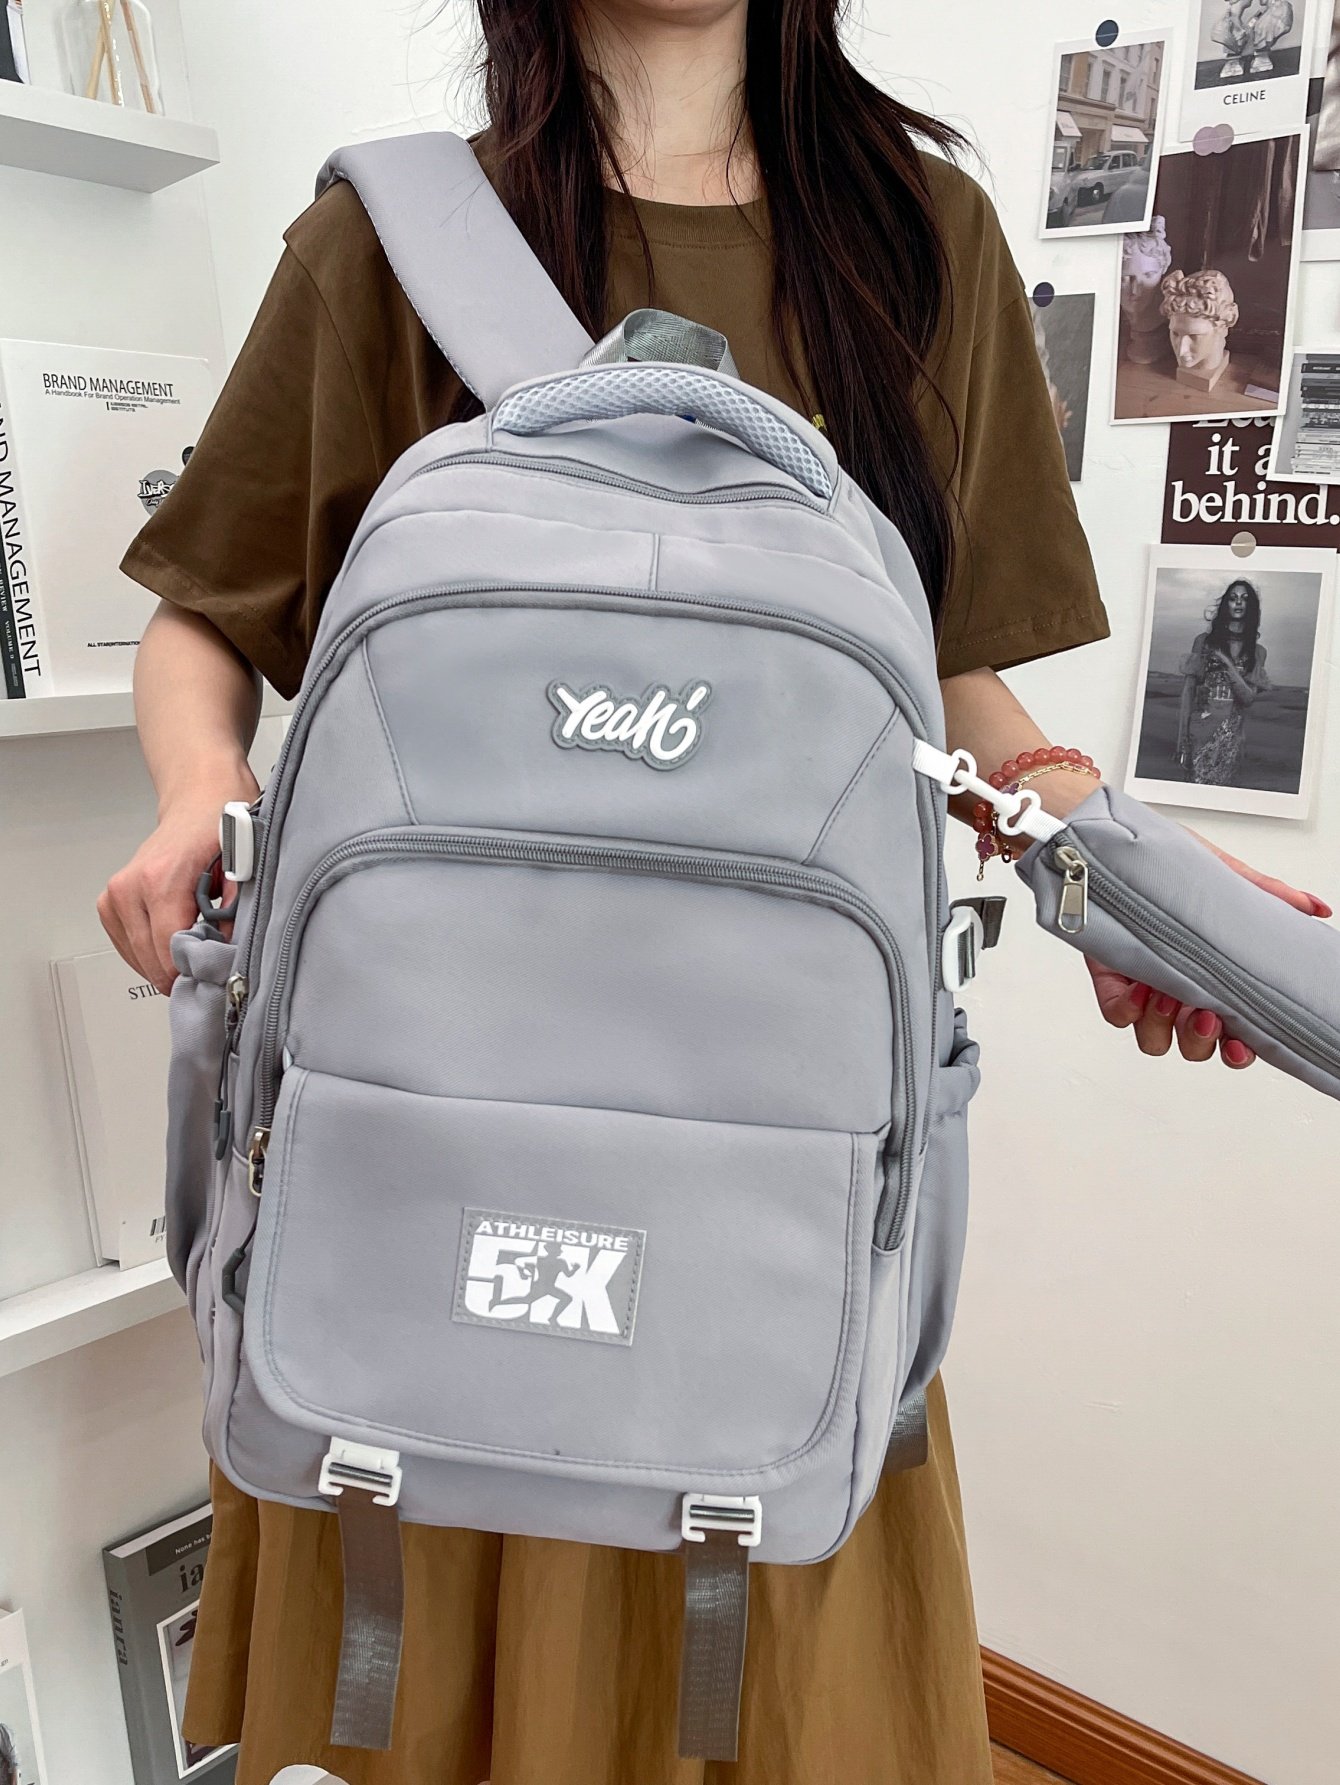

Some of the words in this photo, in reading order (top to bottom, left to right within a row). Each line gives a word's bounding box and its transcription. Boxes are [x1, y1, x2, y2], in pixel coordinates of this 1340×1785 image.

[1223, 89, 1266, 105] CELINE
[42, 373, 87, 391] BRAND
[89, 377, 174, 398] MANAGEMENT
[51, 389, 83, 397] Handbook
[95, 392, 114, 400] Brand
[114, 393, 143, 402] Operation
[143, 395, 181, 405] Management
[1205, 433, 1240, 476] it
[1171, 480, 1340, 525] behind.
[475, 1220, 629, 1251] ATHLEISURE
